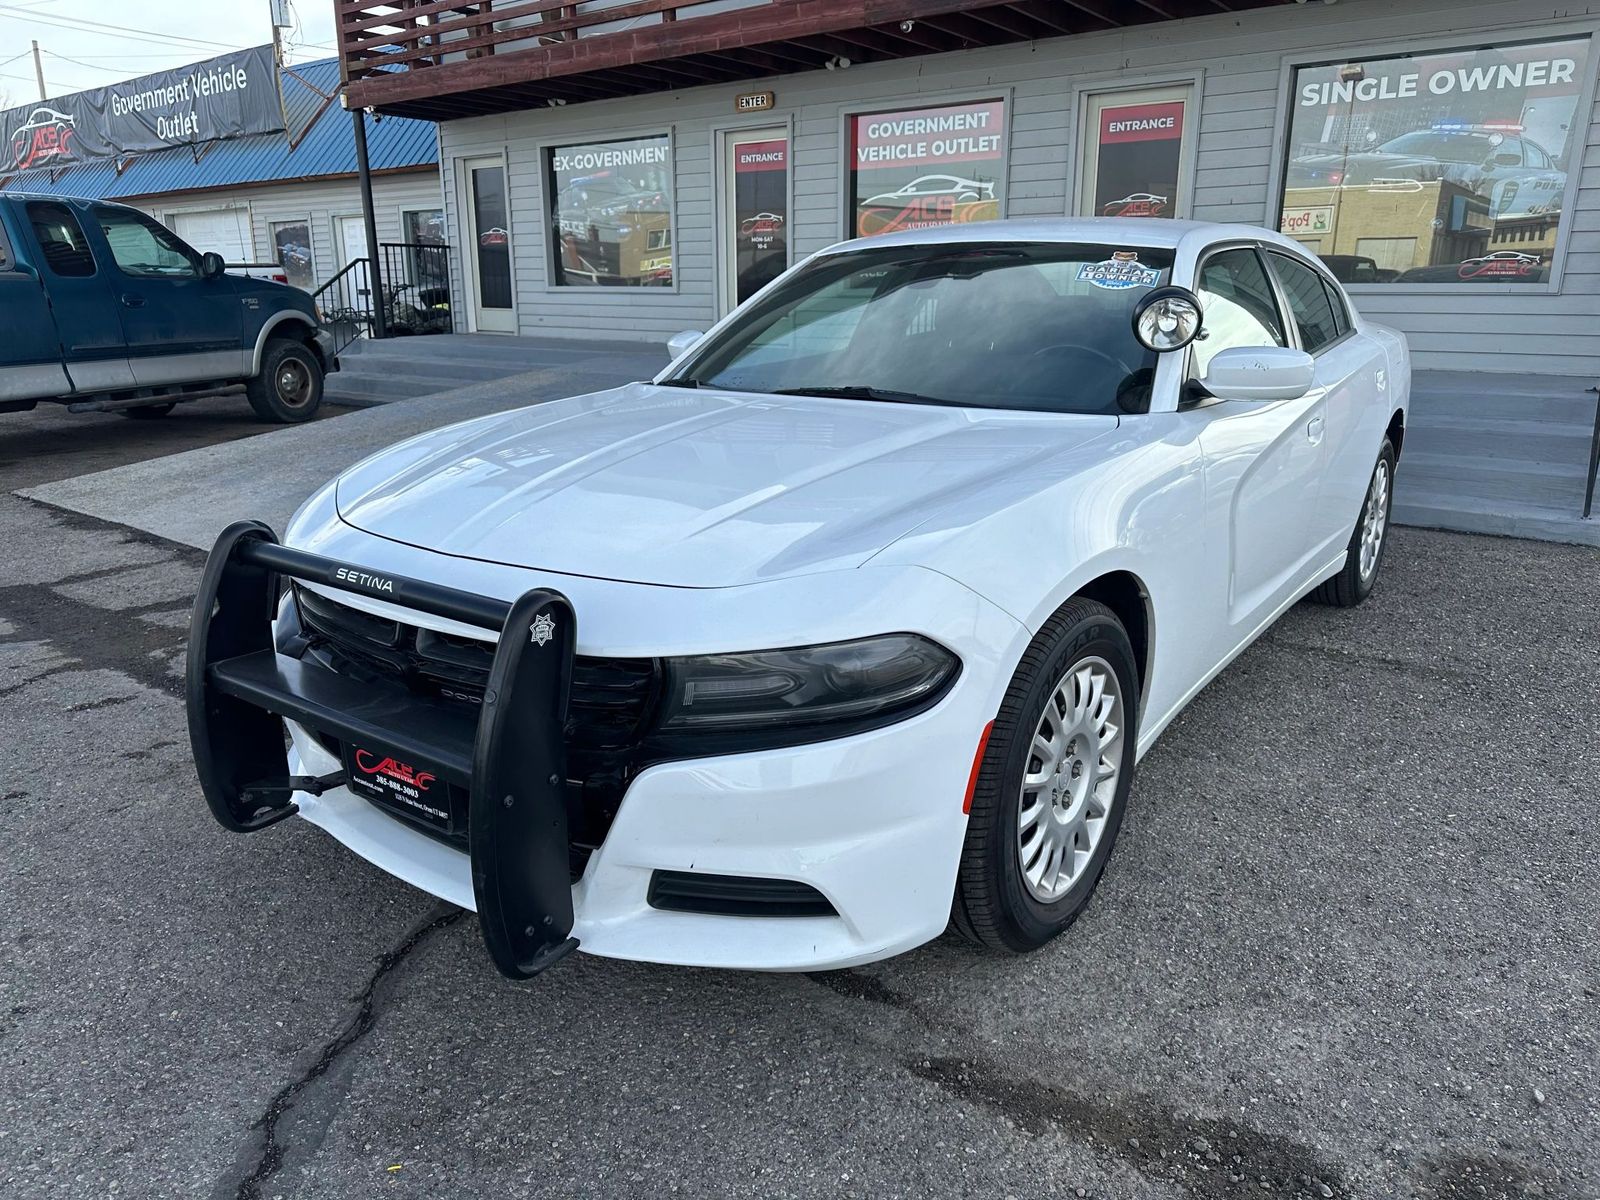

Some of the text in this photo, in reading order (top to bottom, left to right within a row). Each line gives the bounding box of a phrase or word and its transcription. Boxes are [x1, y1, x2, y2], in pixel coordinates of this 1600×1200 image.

[112, 65, 247, 116] Government Vehicle
[1300, 58, 1577, 106] SINGLE OWNER
[739, 95, 767, 108] ENTER
[156, 111, 199, 140] Outlet
[867, 111, 990, 139] GOVERNMENT
[1108, 117, 1175, 133] ENTRANCE
[552, 146, 669, 172] EX-GOVERNMEN
[740, 152, 784, 164] ENTRANCE
[857, 135, 1001, 163] VEHICLE OUTLET
[1084, 265, 1155, 278] CARFAX
[1094, 273, 1153, 285] OWNER
[336, 567, 393, 593] SETINA
[440, 688, 483, 704] DOD
